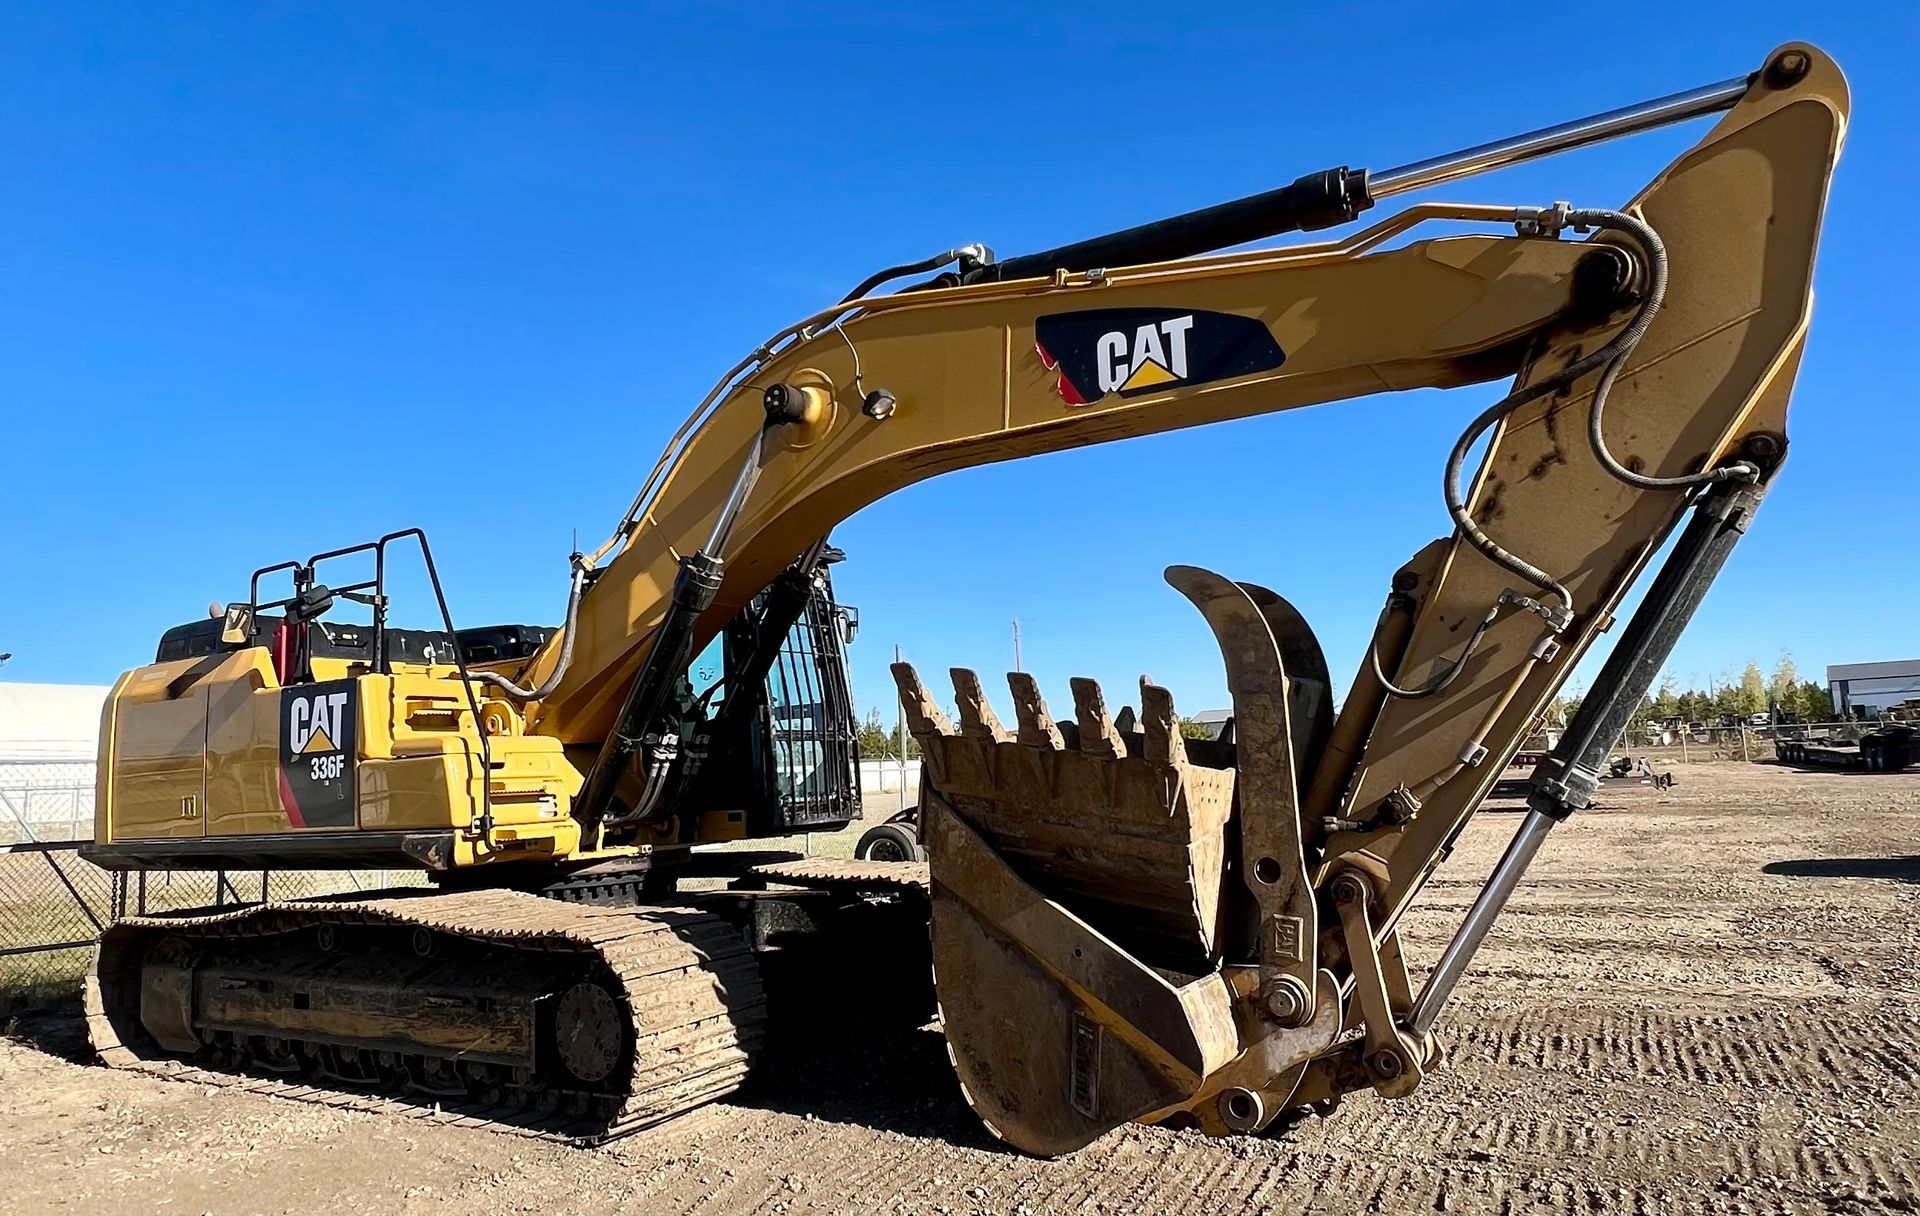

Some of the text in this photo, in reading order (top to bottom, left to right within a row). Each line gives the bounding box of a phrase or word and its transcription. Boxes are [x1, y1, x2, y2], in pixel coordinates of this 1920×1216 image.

[1097, 315, 1193, 392] CAT
[290, 692, 348, 754] CAT
[311, 755, 345, 780] 336F
